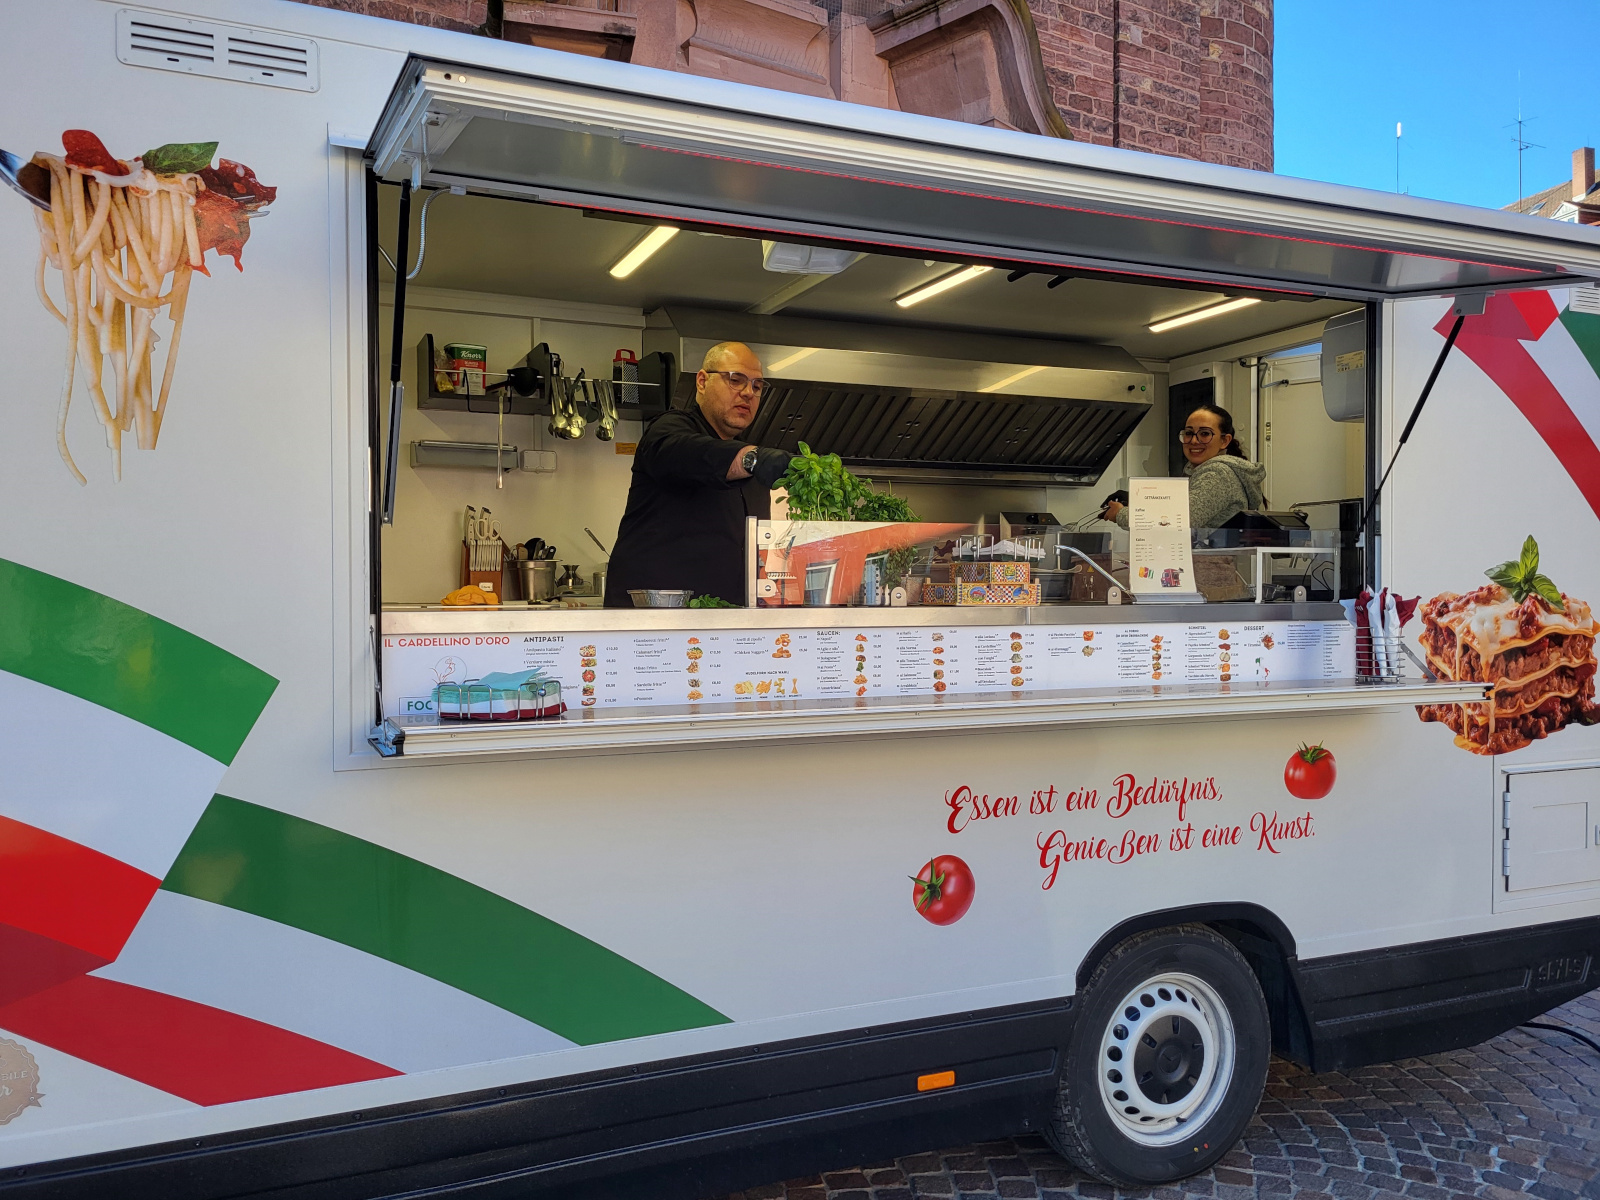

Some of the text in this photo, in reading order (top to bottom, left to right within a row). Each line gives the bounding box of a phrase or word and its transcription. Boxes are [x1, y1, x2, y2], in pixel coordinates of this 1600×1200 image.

[460, 350, 483, 359] Knorr
[384, 636, 510, 648] IL CARDELLINO D'ORO
[945, 773, 1223, 833] Essen ist ein Bedürfnis,
[1169, 822, 1195, 852] ist
[1201, 823, 1243, 849] eine
[1250, 810, 1317, 854] Kunst.
